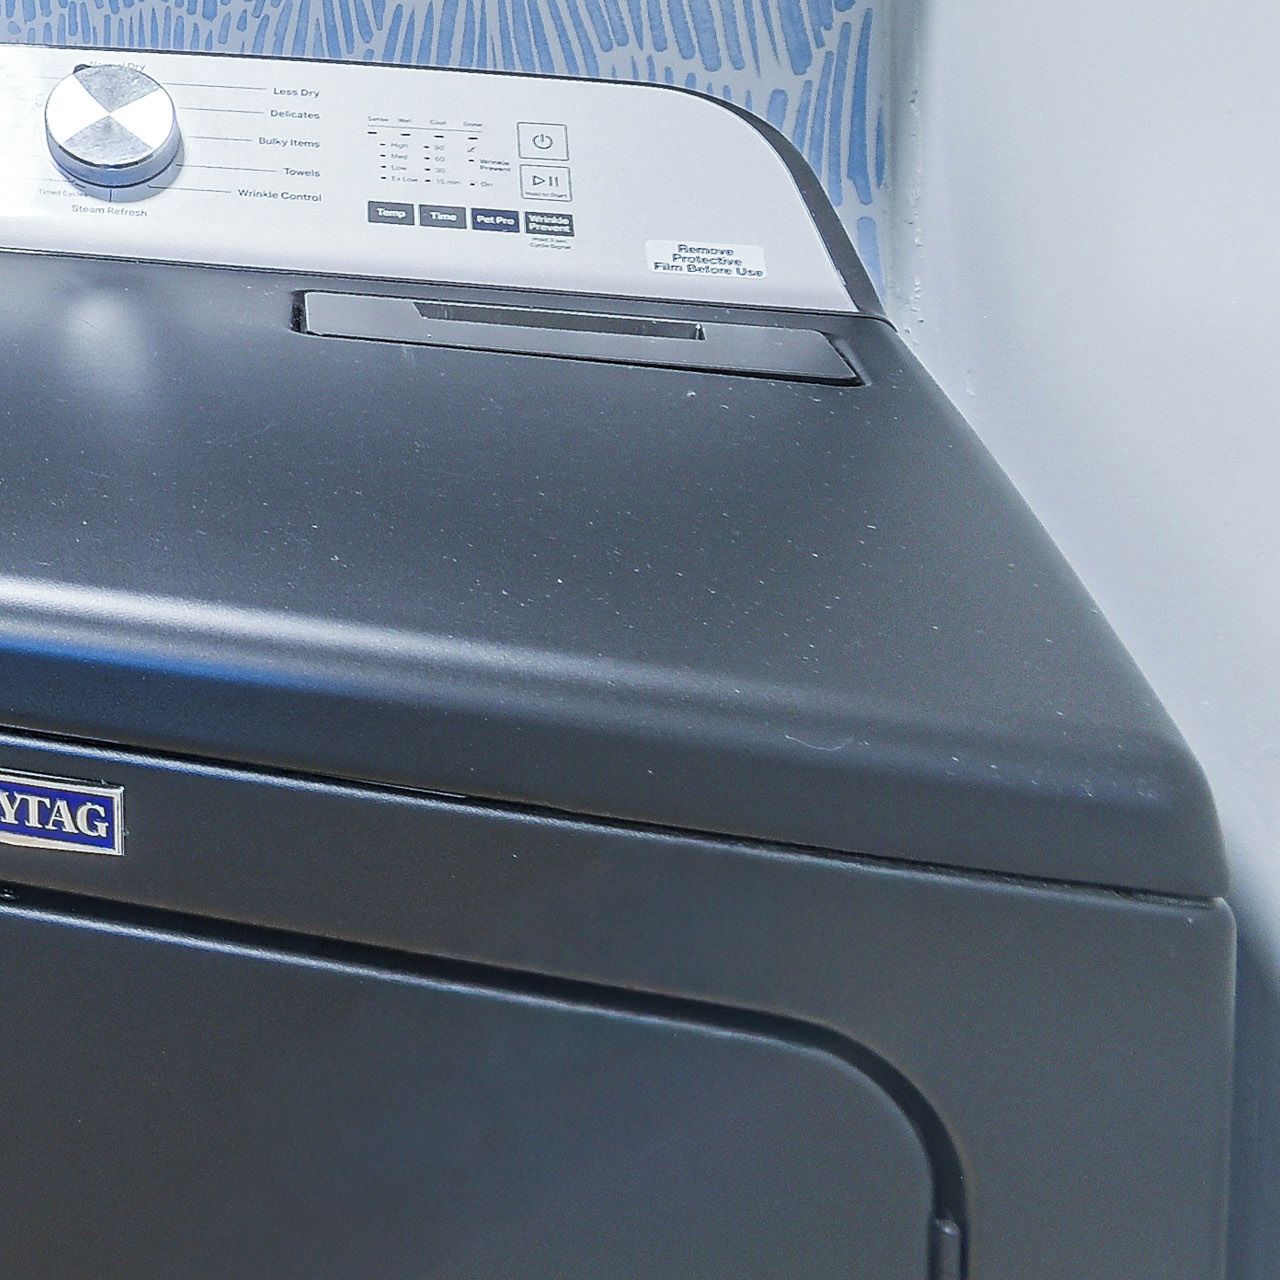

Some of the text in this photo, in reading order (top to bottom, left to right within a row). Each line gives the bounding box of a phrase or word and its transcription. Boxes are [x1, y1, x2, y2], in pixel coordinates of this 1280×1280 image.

[273, 87, 320, 99] Less Dry
[270, 109, 320, 120] Delicates
[258, 137, 320, 148] Bulky Items
[283, 167, 321, 177] Towels
[237, 189, 322, 202] Wrinkle Control
[71, 204, 148, 217] Steam Refresh
[376, 207, 407, 219] Temp
[430, 211, 458, 221] Time
[476, 214, 516, 226] Pet Pro
[528, 214, 570, 225] Wrinkle
[528, 223, 571, 233] Prevent
[677, 243, 735, 256] Remove
[671, 253, 743, 266] Protective
[653, 261, 764, 277] Film Before Use
